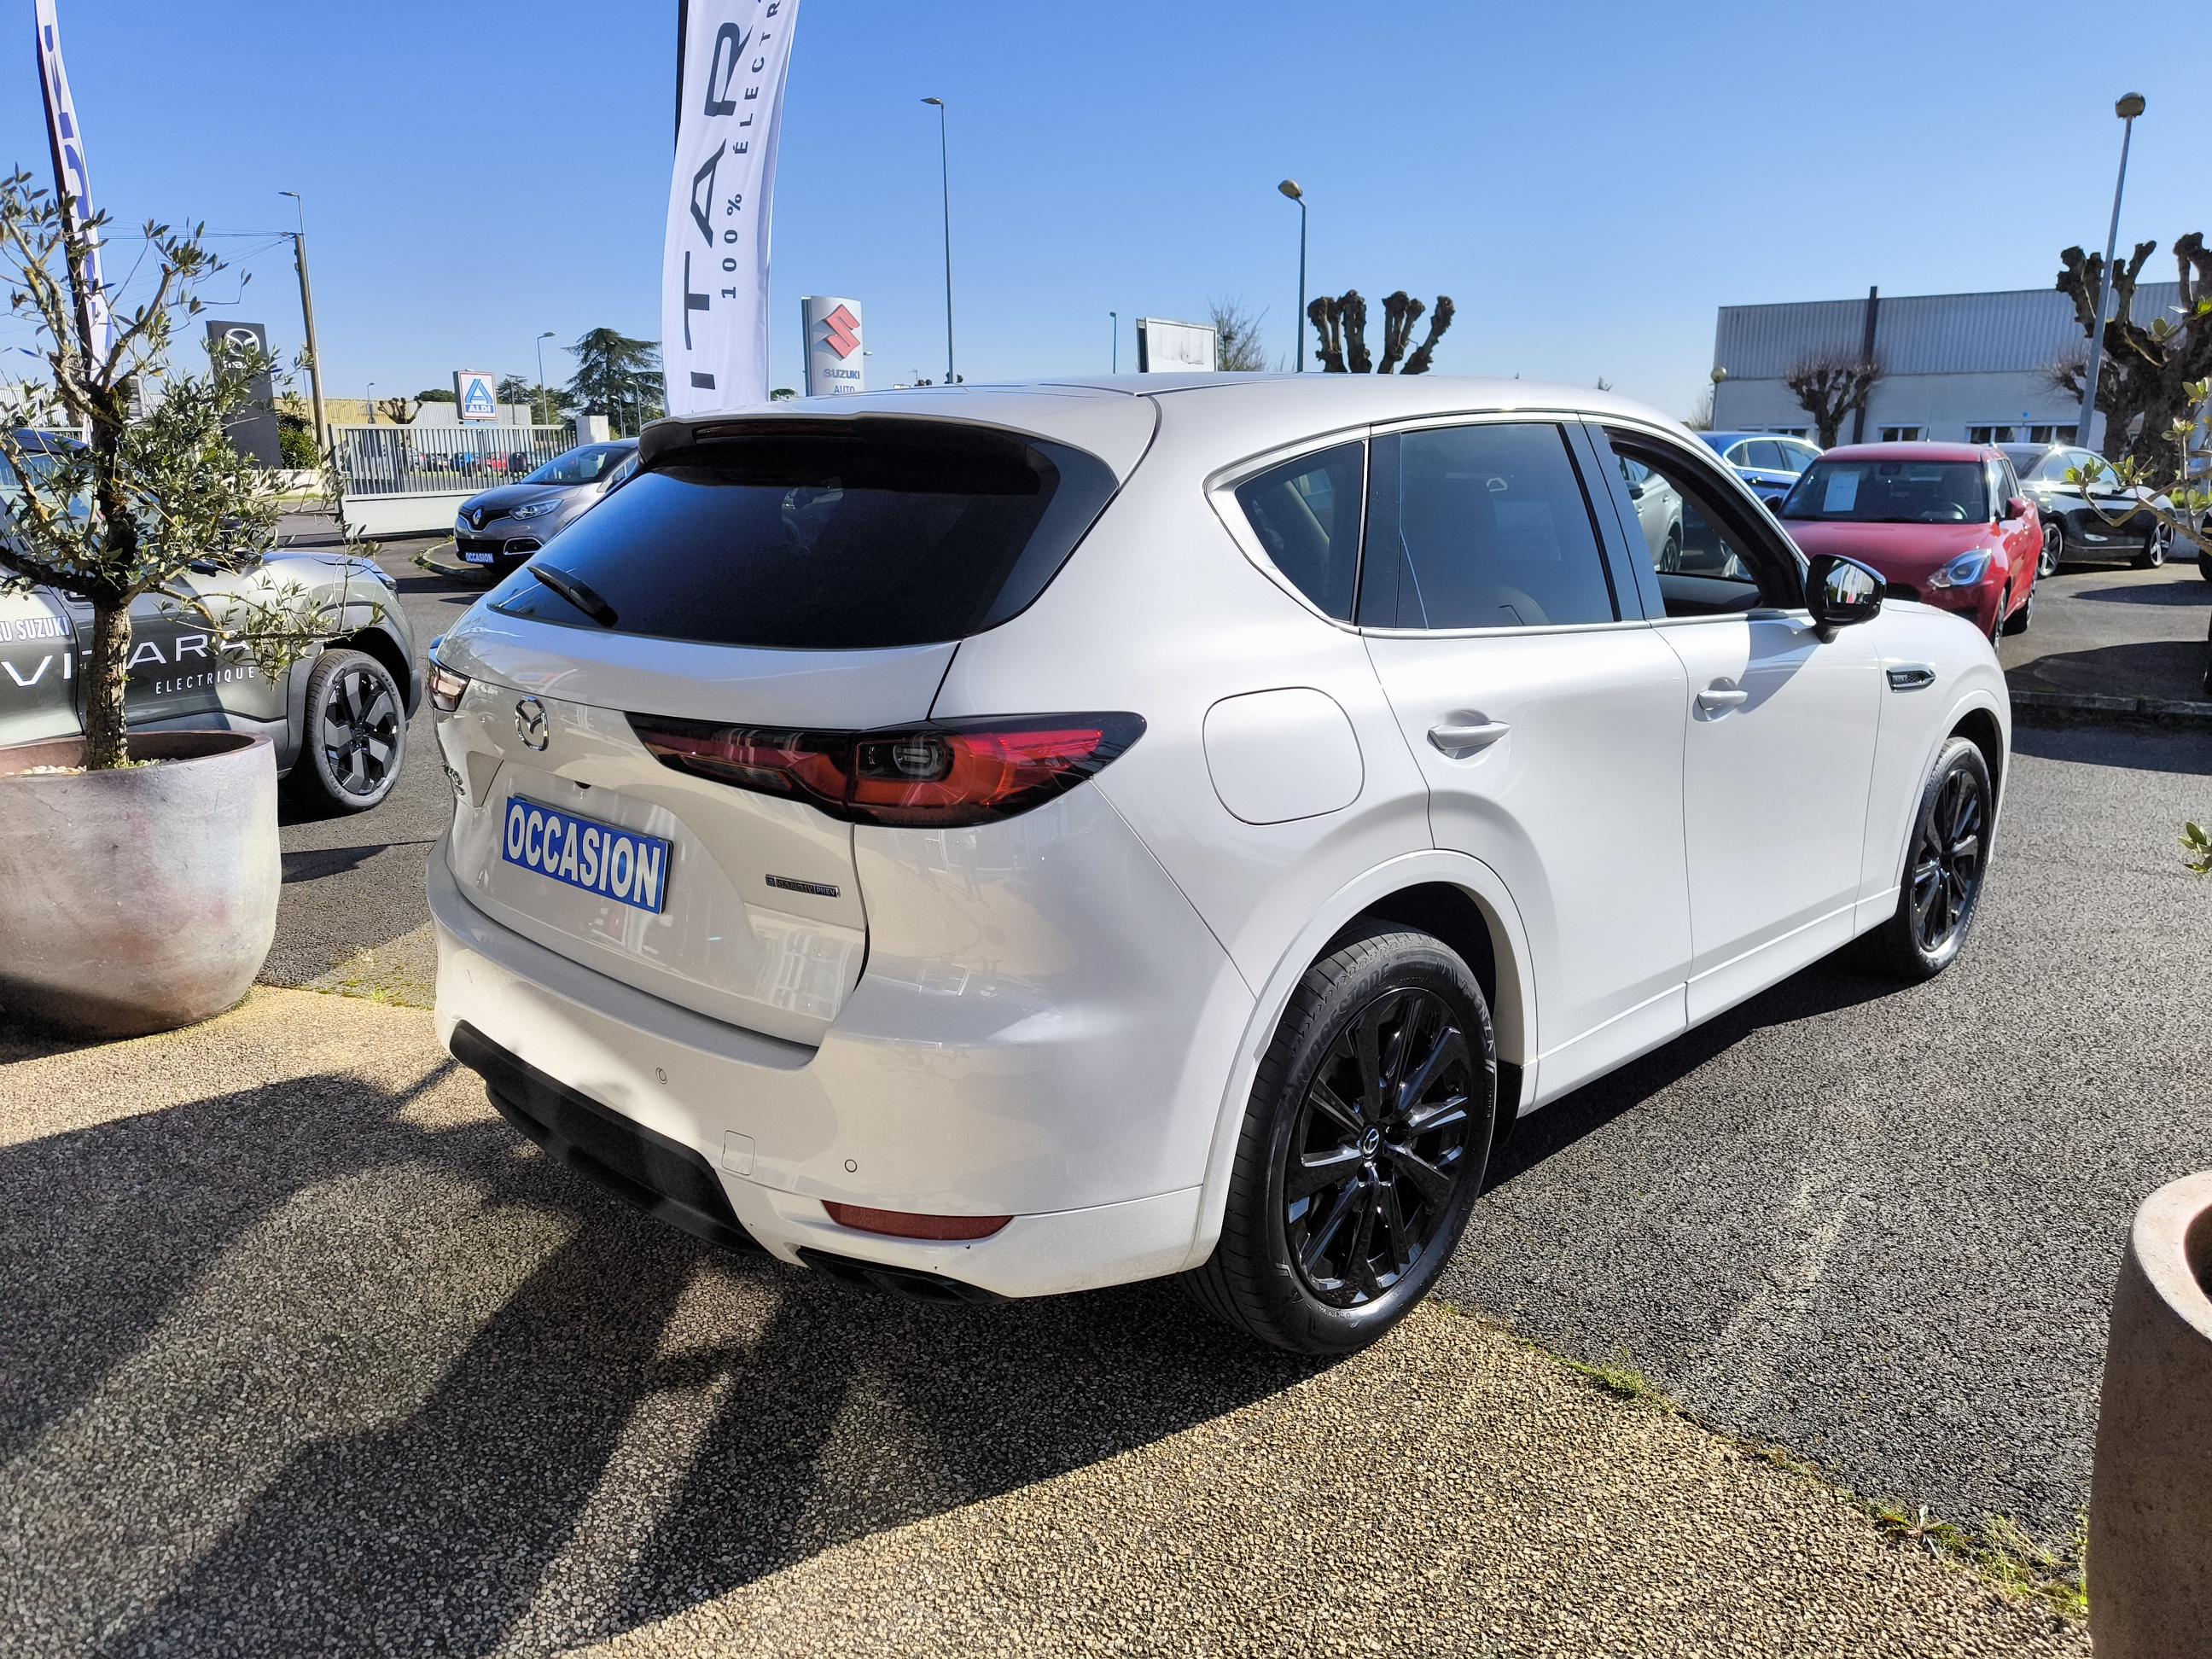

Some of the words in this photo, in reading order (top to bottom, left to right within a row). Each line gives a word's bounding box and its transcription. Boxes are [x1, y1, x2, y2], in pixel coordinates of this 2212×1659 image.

[684, 0, 760, 389] ITAR
[824, 369, 860, 380] SUZUKI
[835, 386, 855, 394] AUTO
[469, 405, 492, 413] ALDI
[465, 552, 493, 562] OCCASION
[15, 616, 70, 640] SUZUKI
[507, 804, 661, 908] OCCASION
